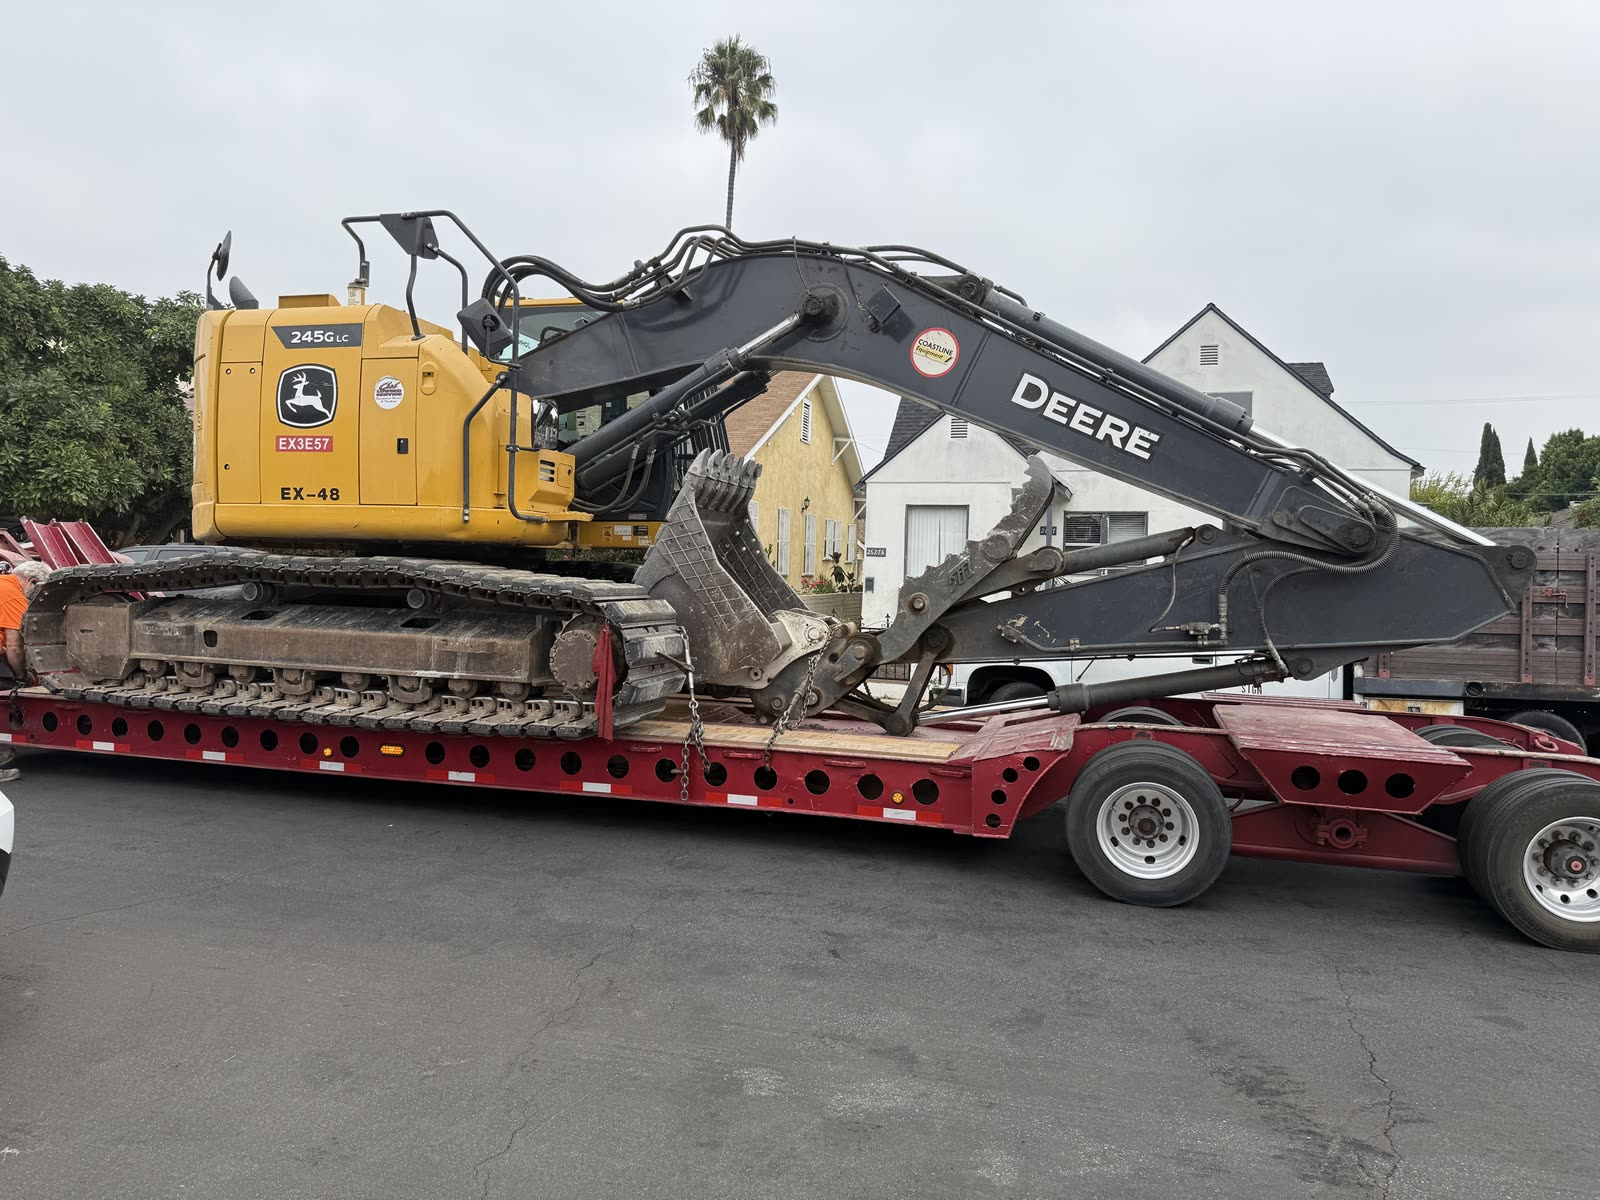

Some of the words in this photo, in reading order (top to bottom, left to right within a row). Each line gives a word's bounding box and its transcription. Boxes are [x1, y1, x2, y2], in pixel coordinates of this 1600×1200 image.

[290, 330, 335, 344] 245G
[336, 334, 349, 342] LC
[916, 345, 944, 359] Equipment
[918, 339, 953, 356] COASTLINE
[1011, 372, 1160, 460] DEERE
[279, 437, 330, 450] EX3E57
[280, 487, 341, 501] EX-48
